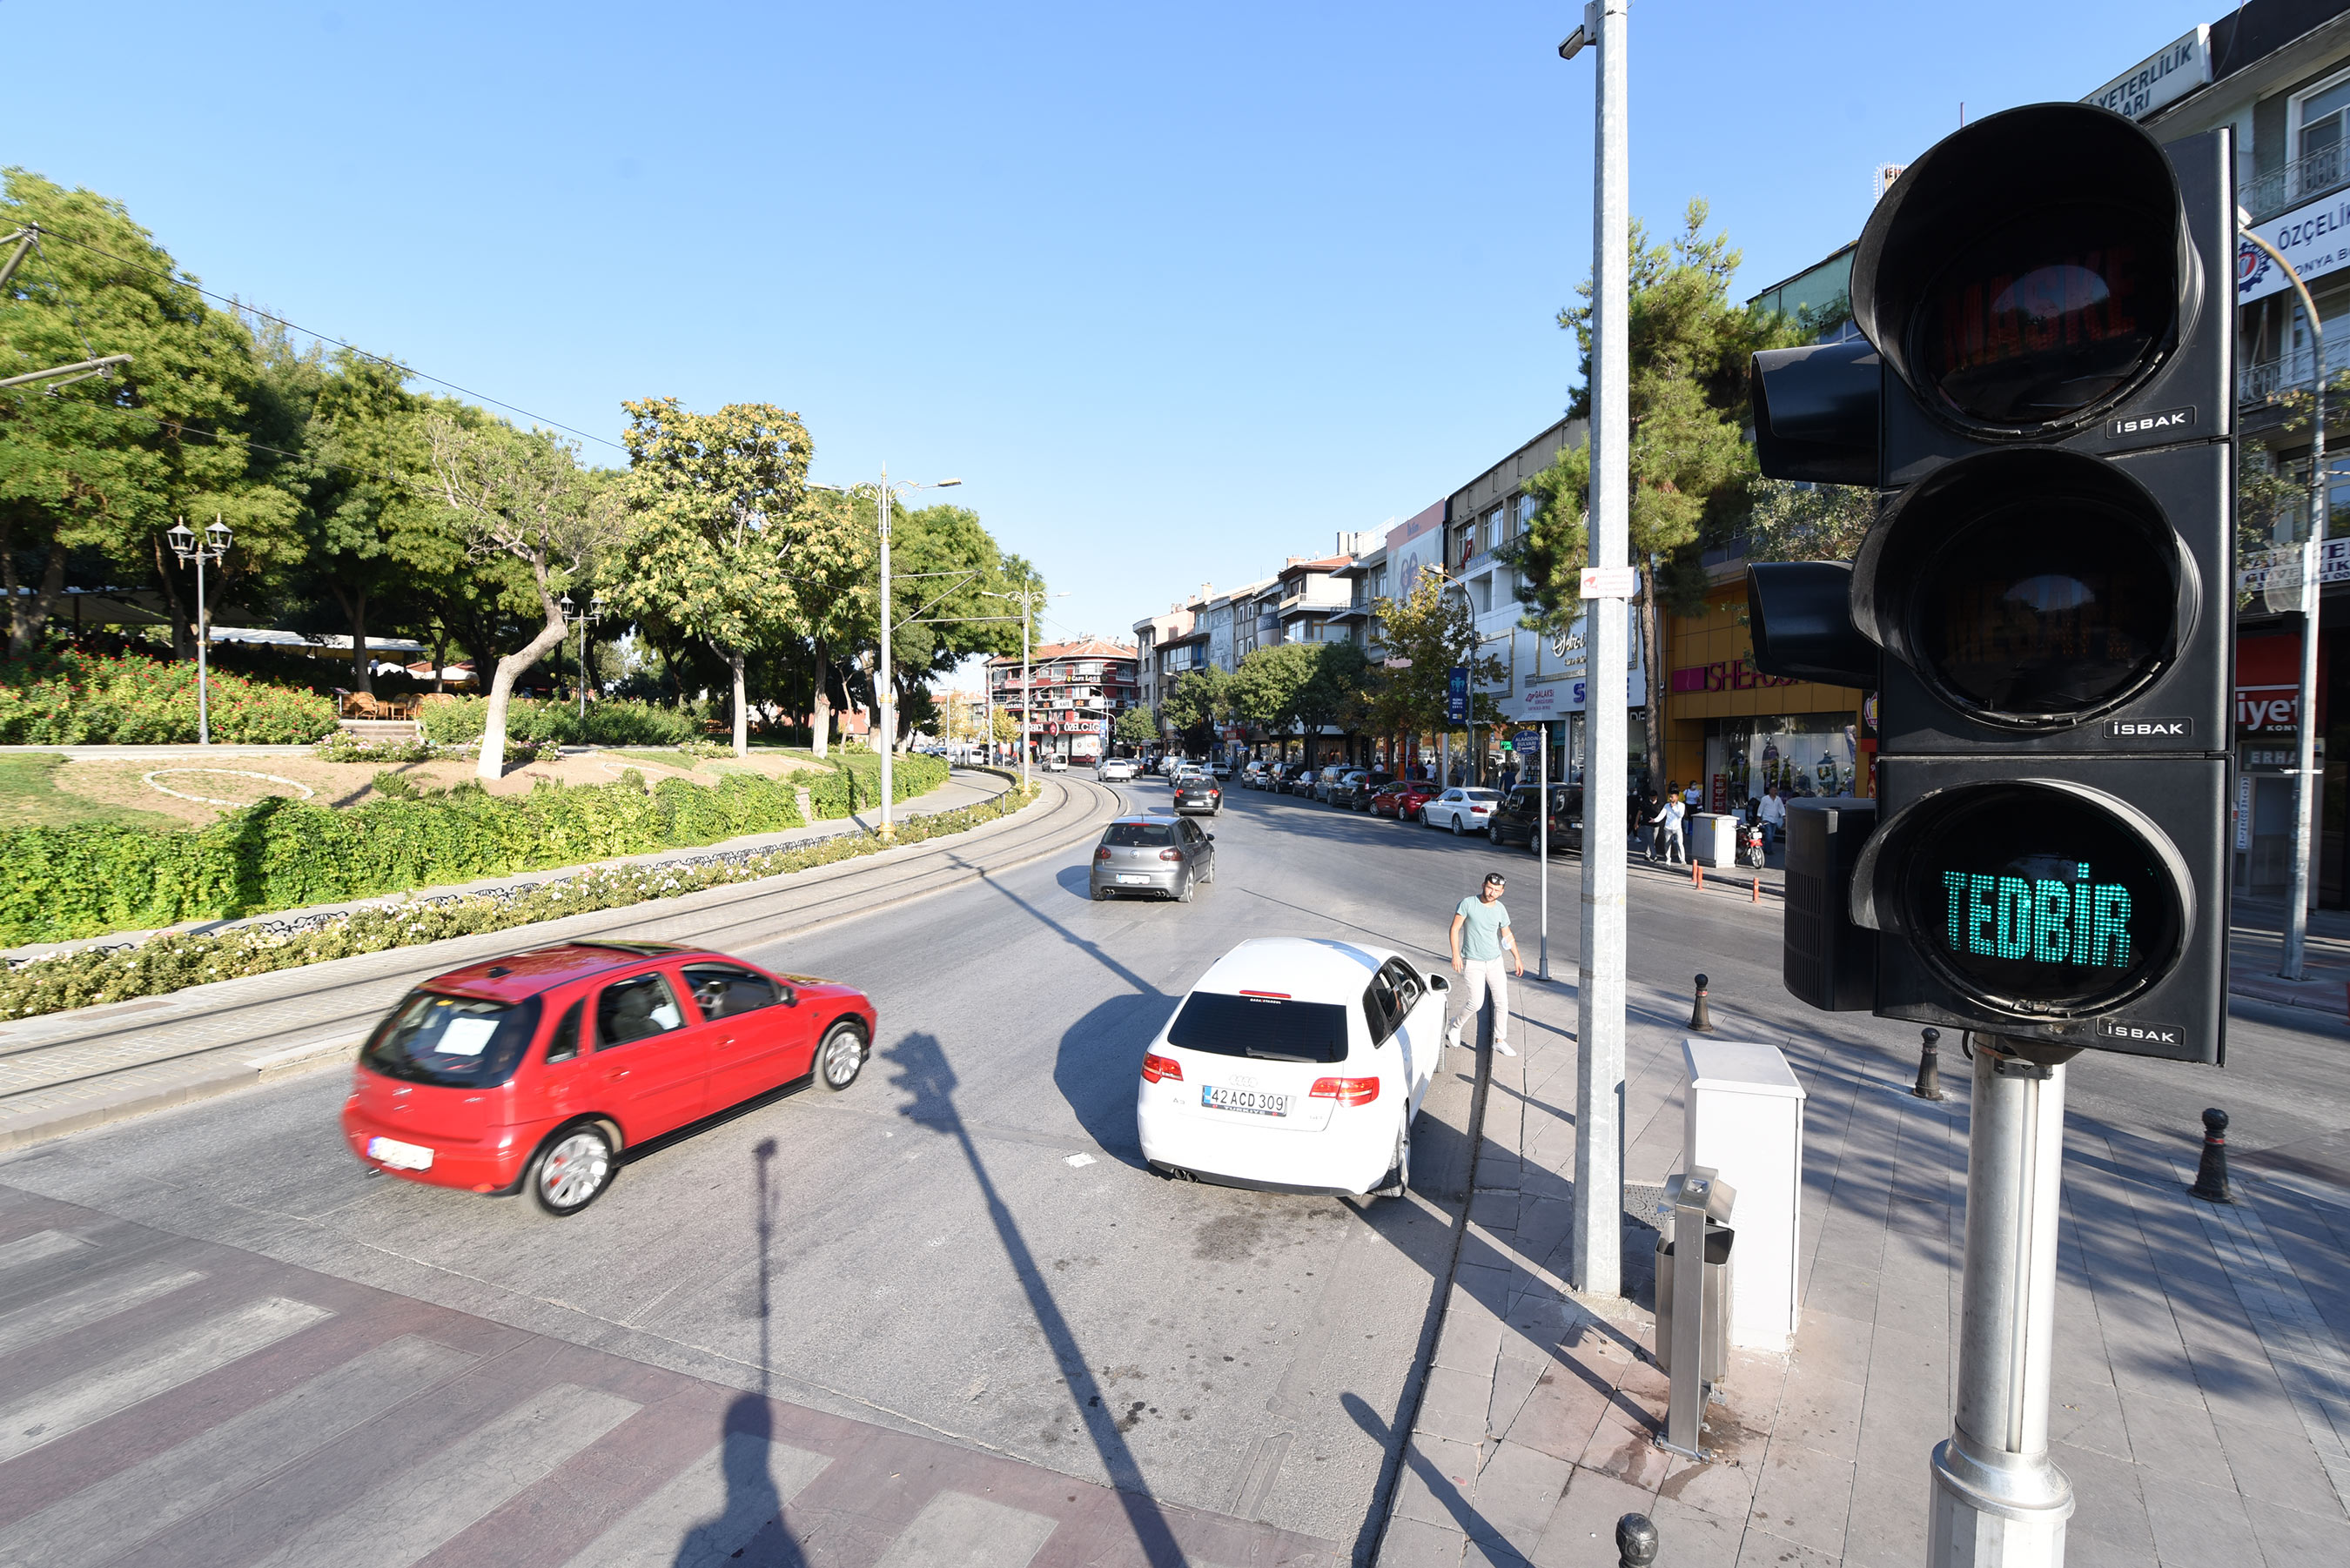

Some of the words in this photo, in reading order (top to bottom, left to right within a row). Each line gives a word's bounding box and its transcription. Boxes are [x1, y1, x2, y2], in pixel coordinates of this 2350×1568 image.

[2114, 89, 2151, 117] ARI
[2278, 202, 2350, 251] ÖZÇELİ
[1942, 861, 2132, 968] TEDBİR
[1212, 1089, 1228, 1104] 42
[1231, 1092, 1255, 1109] ACD
[1259, 1095, 1284, 1111] 309
